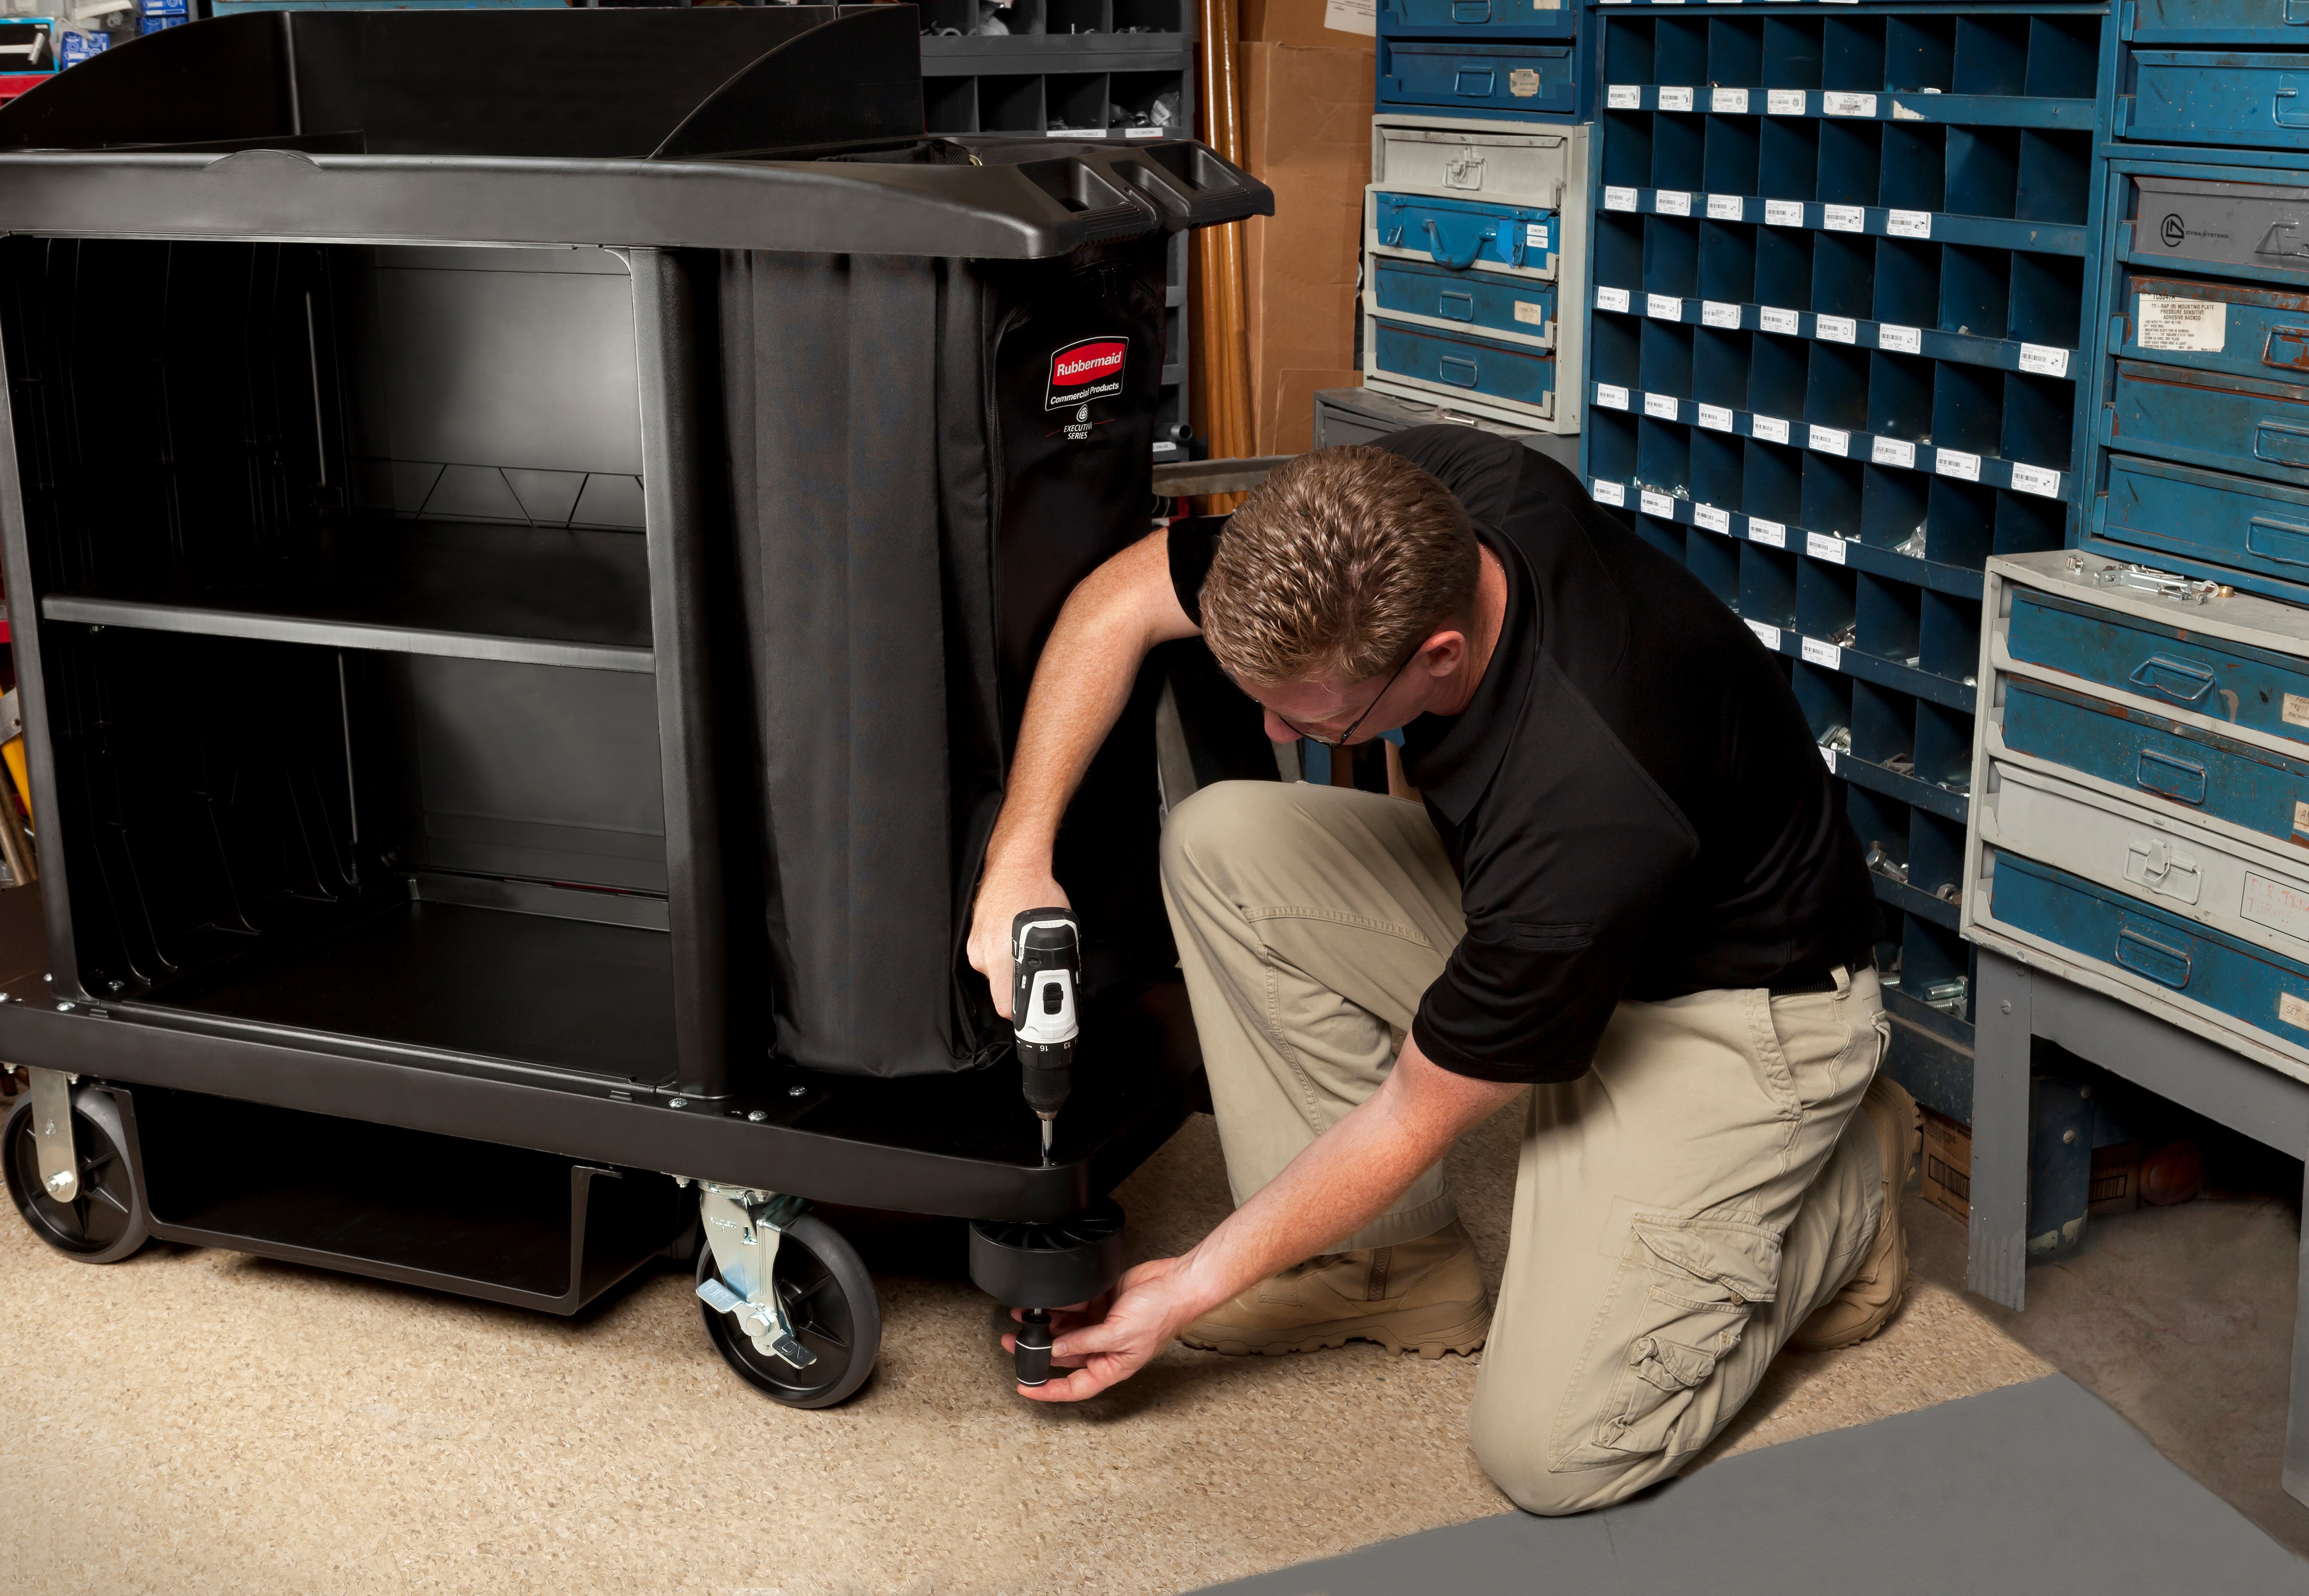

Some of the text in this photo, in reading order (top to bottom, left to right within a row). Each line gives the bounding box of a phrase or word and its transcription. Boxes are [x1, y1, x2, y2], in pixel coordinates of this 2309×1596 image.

[1057, 351, 1122, 377] Rubbermaid
[1050, 382, 1119, 405] Commercial Products
[1063, 421, 1092, 433] EXECUTIVE
[1067, 431, 1087, 439] SERIES
[2291, 703, 2307, 711] TRUSS
[2286, 1006, 2301, 1016] SET
[704, 1284, 733, 1303] OFF
[781, 1340, 807, 1359] ON
